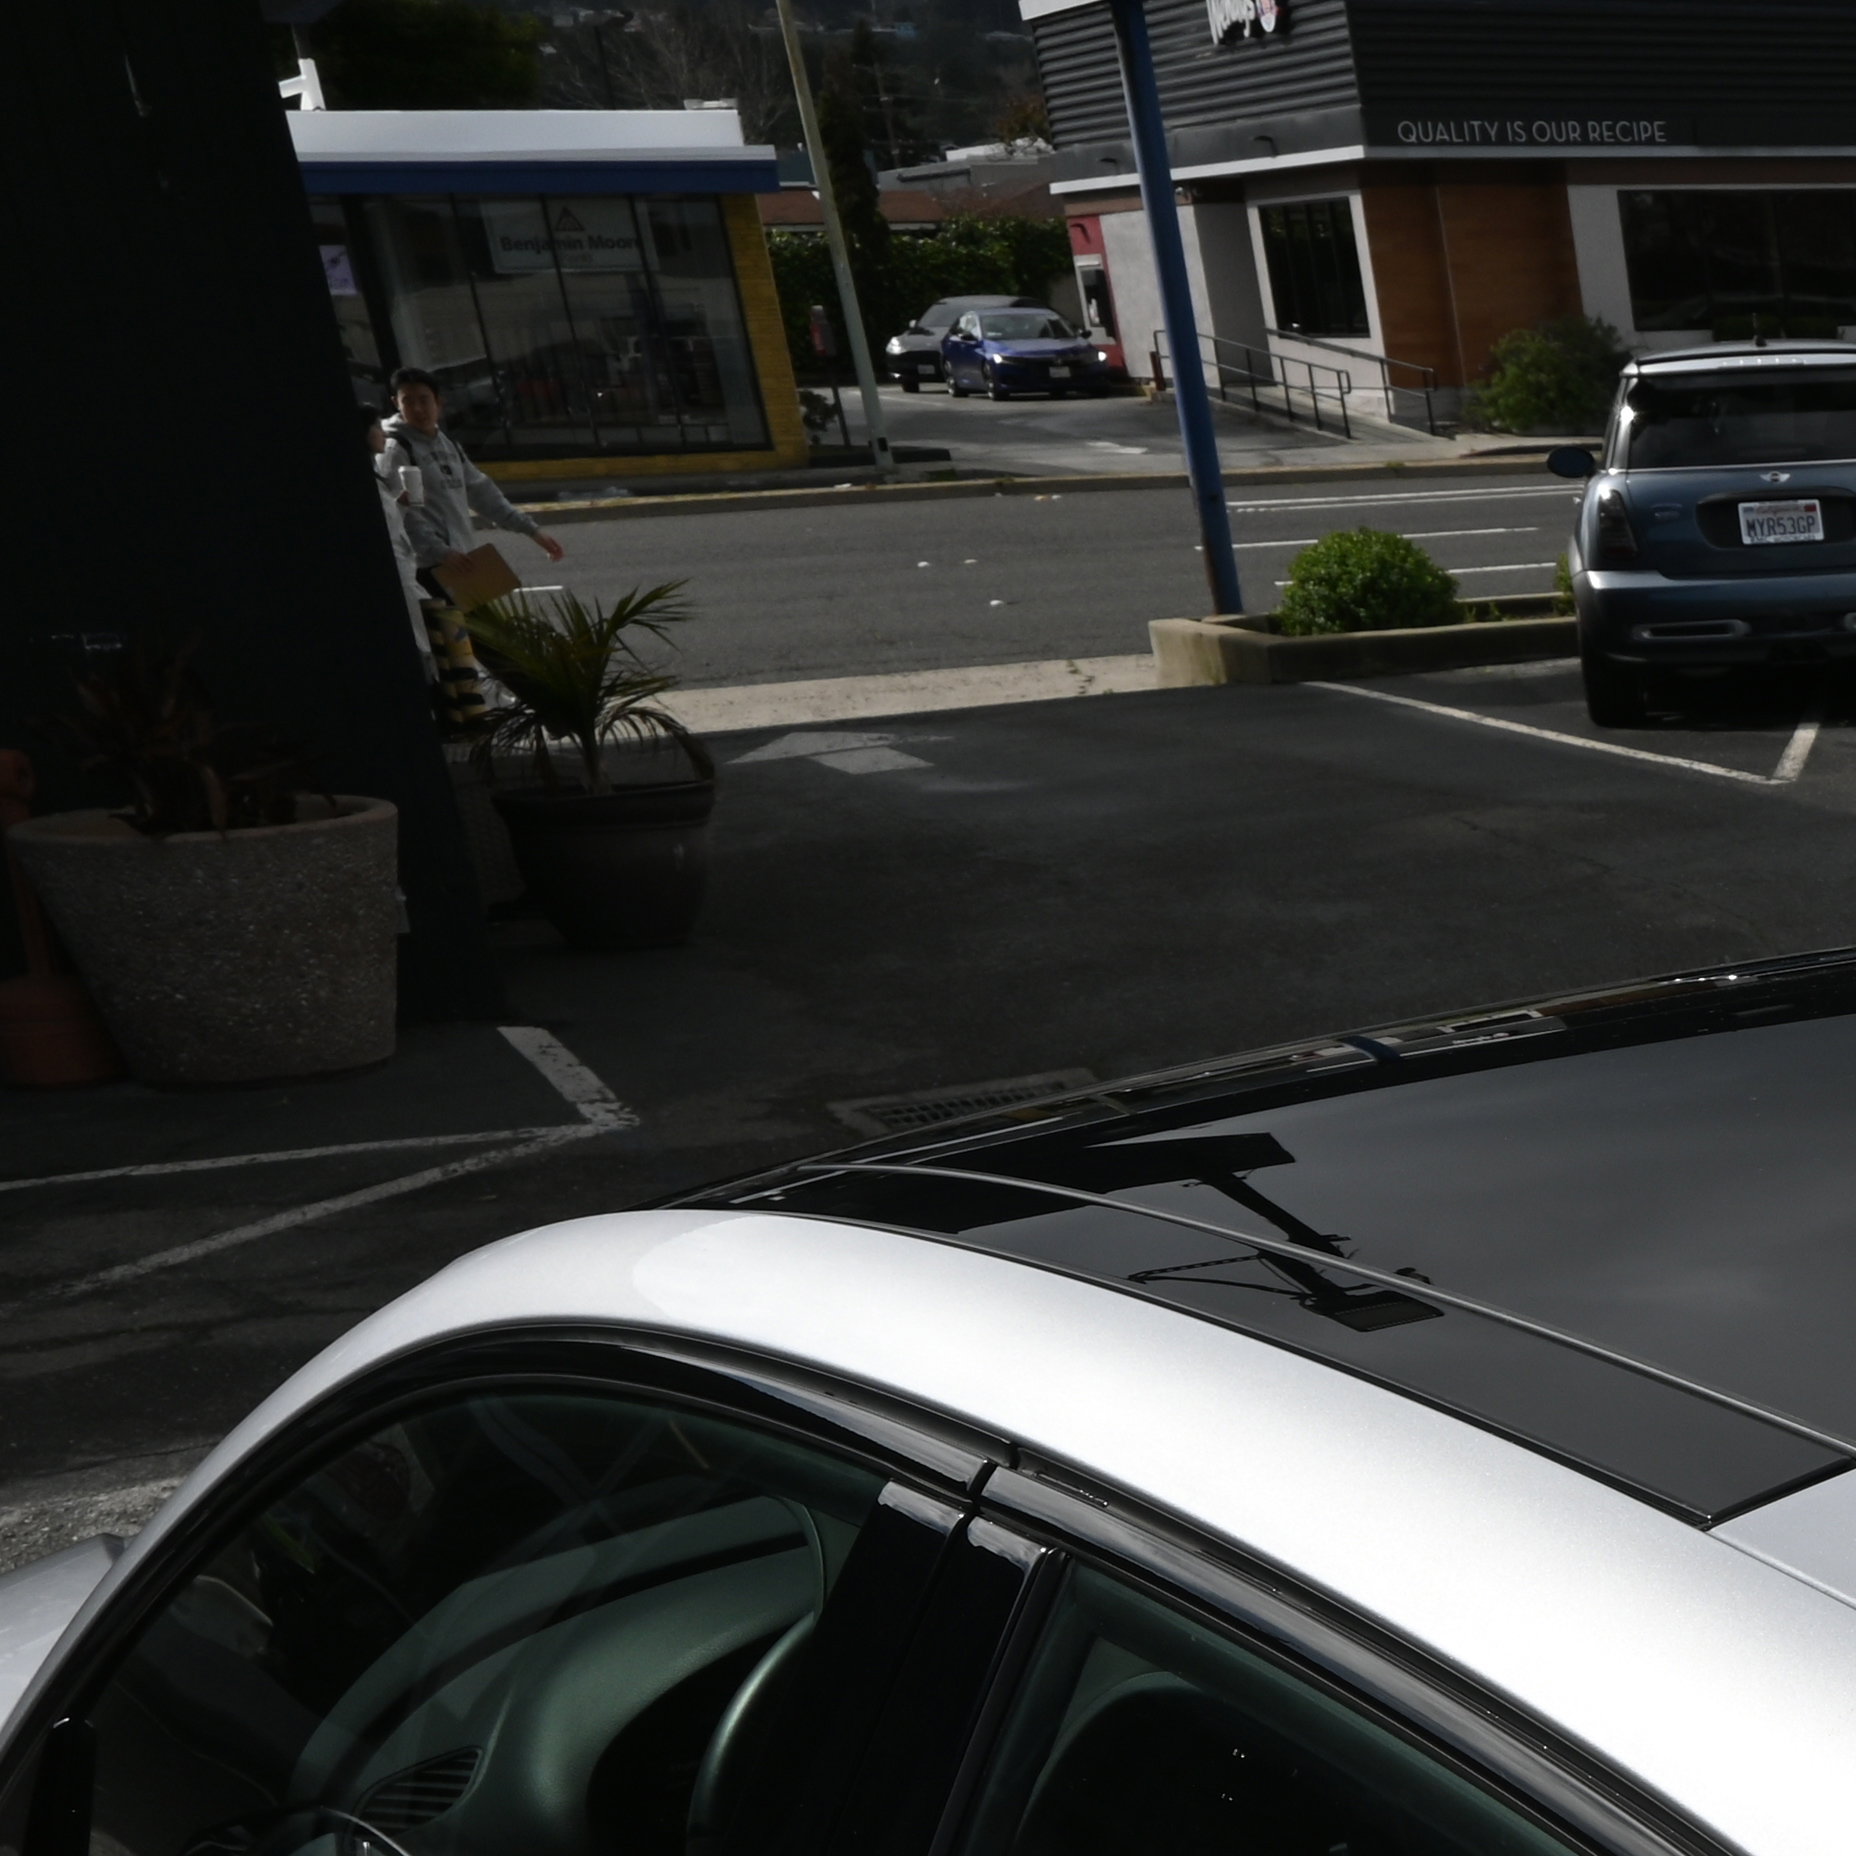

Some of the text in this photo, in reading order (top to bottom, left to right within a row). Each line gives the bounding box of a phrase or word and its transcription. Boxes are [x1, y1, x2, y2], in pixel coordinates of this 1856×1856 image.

[1397, 120, 1667, 143] QUALITY IS OUR RECIPE
